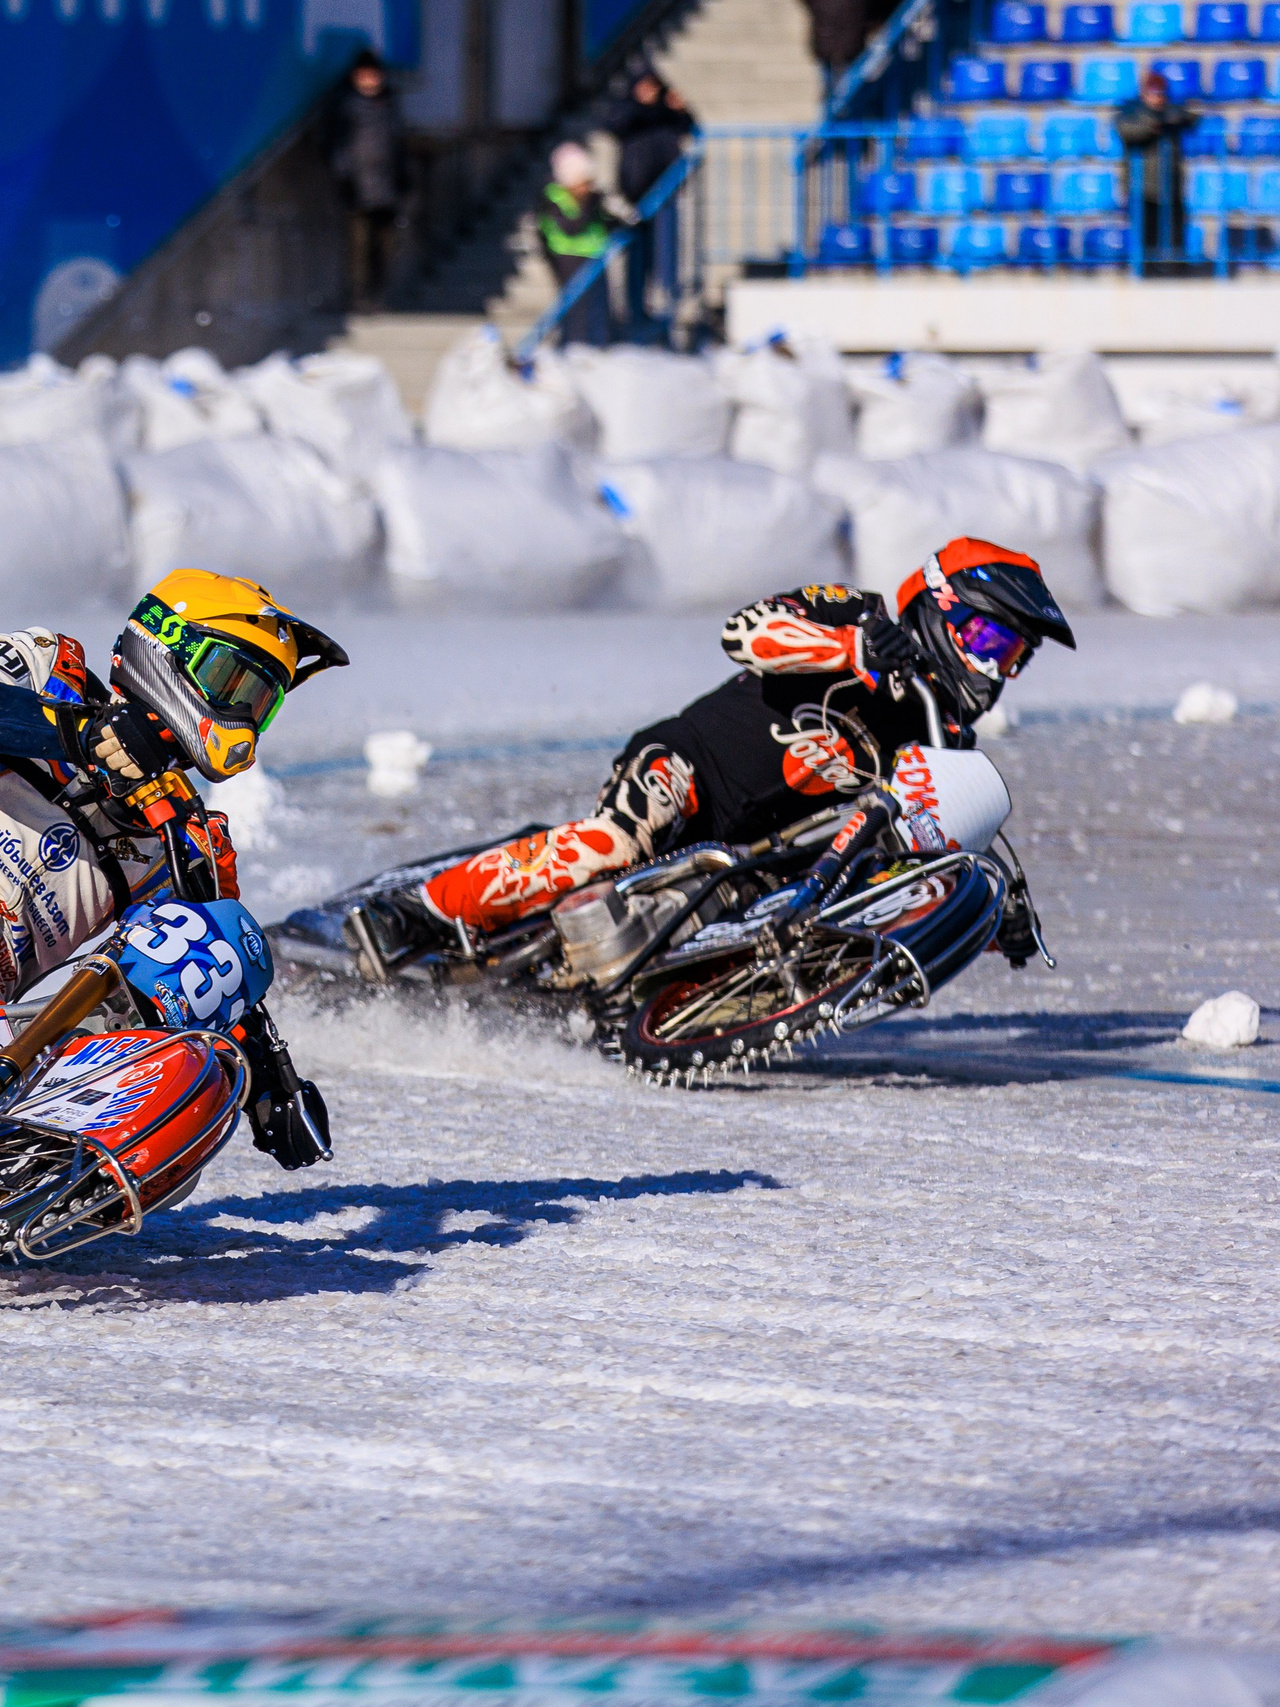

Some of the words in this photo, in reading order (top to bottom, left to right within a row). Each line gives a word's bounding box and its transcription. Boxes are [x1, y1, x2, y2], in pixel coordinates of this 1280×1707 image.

[25, 896, 57, 948] ОБЩЕСТВО
[247, 935, 260, 956] FIM
[76, 1073, 164, 1132] LADA
